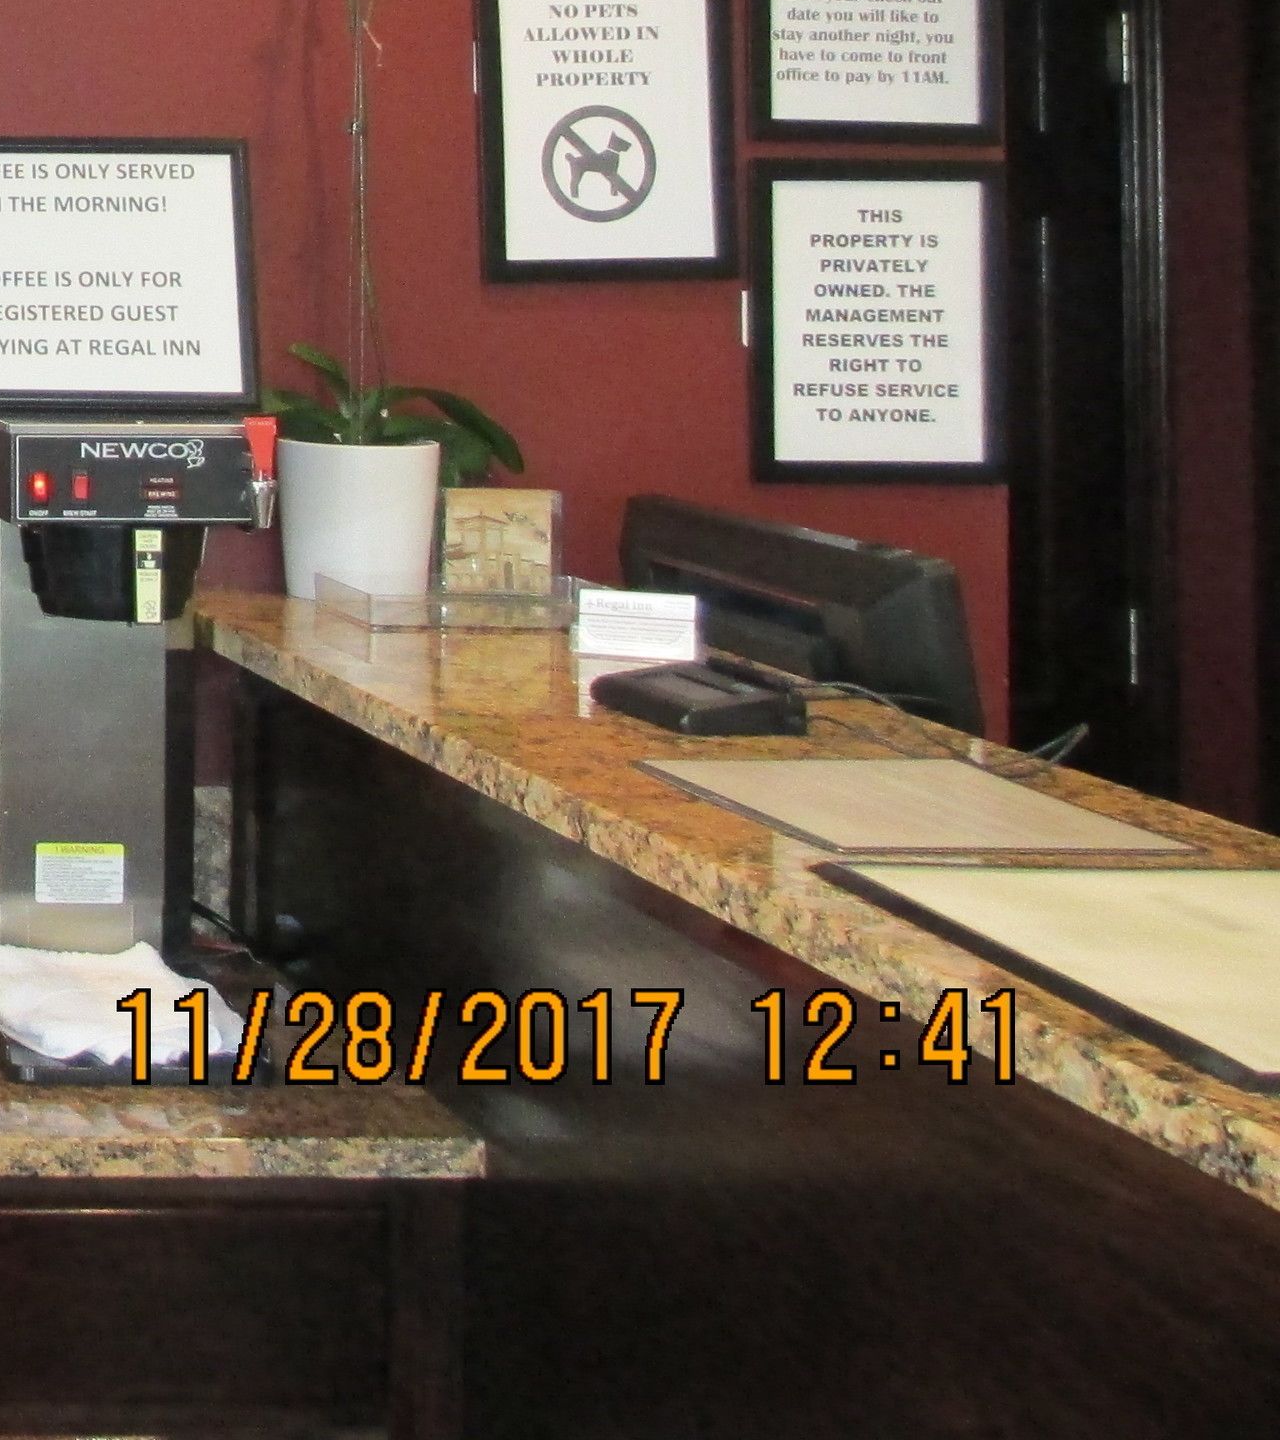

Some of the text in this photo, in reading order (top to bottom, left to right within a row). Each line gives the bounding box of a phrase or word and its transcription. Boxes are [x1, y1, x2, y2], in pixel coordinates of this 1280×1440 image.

[549, 4, 638, 19] NO PETS
[787, 8, 939, 25] date you will like to
[523, 26, 660, 42] ALLOWED IN
[773, 28, 954, 46] stay another night, you
[552, 49, 633, 64] WHOLE
[779, 48, 947, 64] have to come to front
[537, 72, 652, 87] PROPERTY
[777, 69, 949, 85] office to pay by 11AM.
[32, 163, 48, 180] IS
[56, 163, 110, 180] ONLY
[117, 163, 195, 180] SERVED
[9, 196, 47, 212] THE
[54, 196, 167, 213] MORNING!
[858, 209, 902, 223] THIS
[810, 234, 939, 248] PROPERTY IS
[820, 259, 929, 273] PRIVATELY
[56, 271, 71, 287] IS
[79, 271, 134, 287] ONLY
[141, 271, 181, 287] FOR
[814, 284, 936, 298] OWNED. THE
[111, 305, 178, 322] GUEST
[806, 309, 944, 323] MANAGEMENT
[56, 339, 83, 356] AT
[90, 339, 156, 356] REGAL
[163, 339, 201, 356] INN
[802, 334, 949, 348] RESERVES THE
[829, 359, 922, 372] RIGHT TO
[793, 384, 959, 398] REFUSE SERVICE
[816, 409, 936, 423] TO ANYONE.
[80, 441, 188, 459] NEWCO
